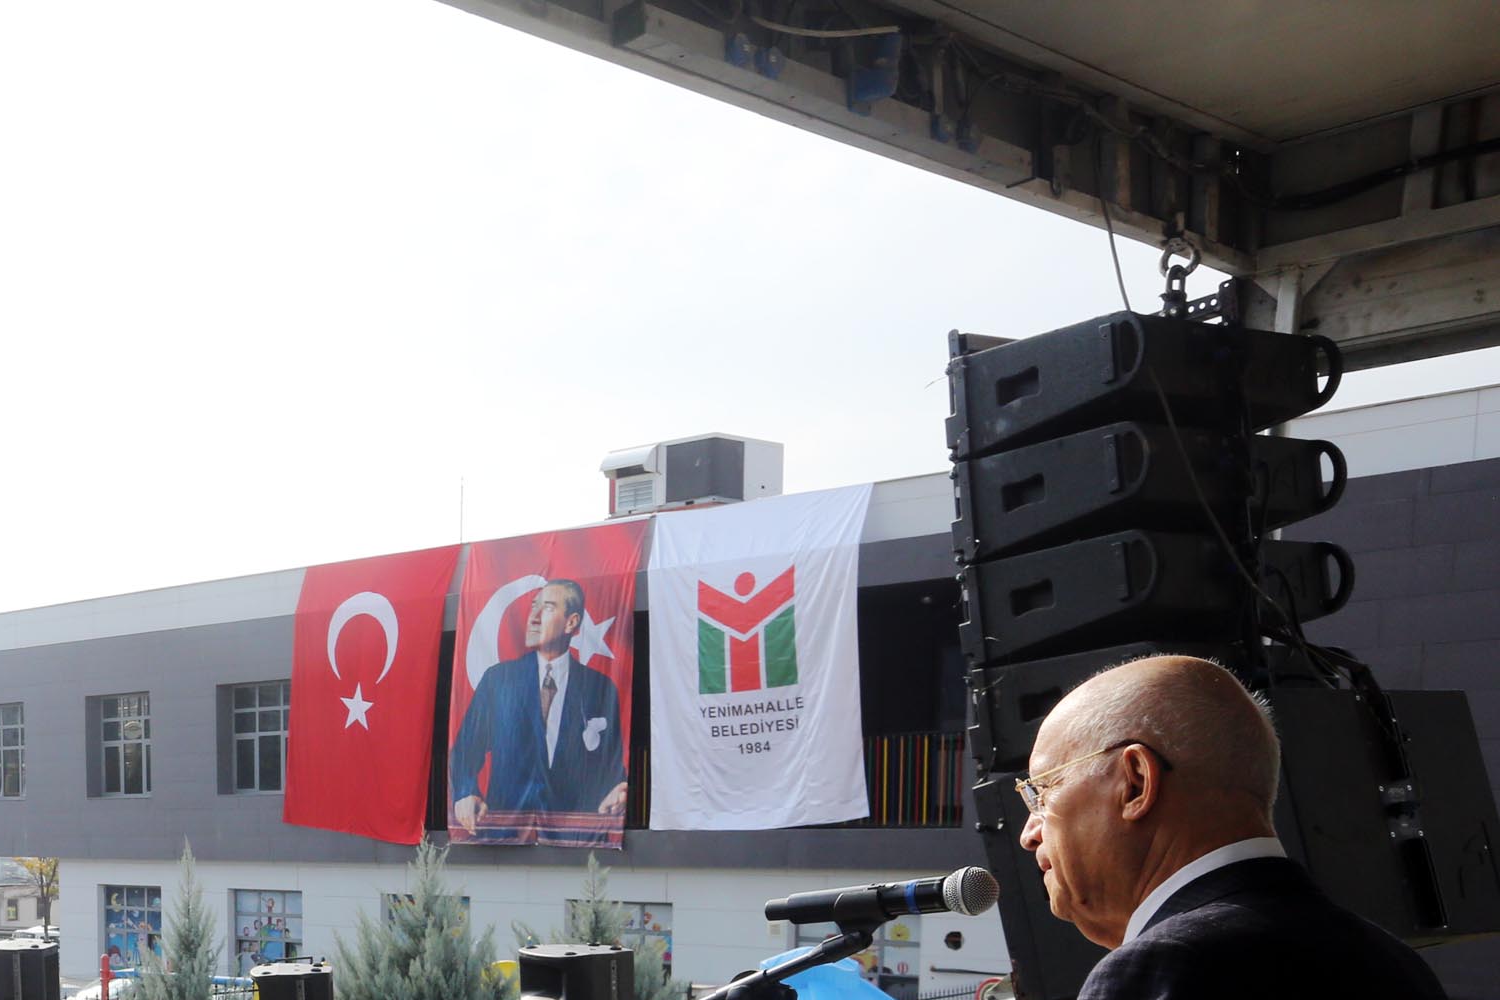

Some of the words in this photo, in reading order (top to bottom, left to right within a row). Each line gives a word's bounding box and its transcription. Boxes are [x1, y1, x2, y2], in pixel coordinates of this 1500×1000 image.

[700, 697, 804, 718] YENİMAHALLE
[711, 715, 799, 737] BELEDİYESİ
[738, 741, 771, 755] 1984
